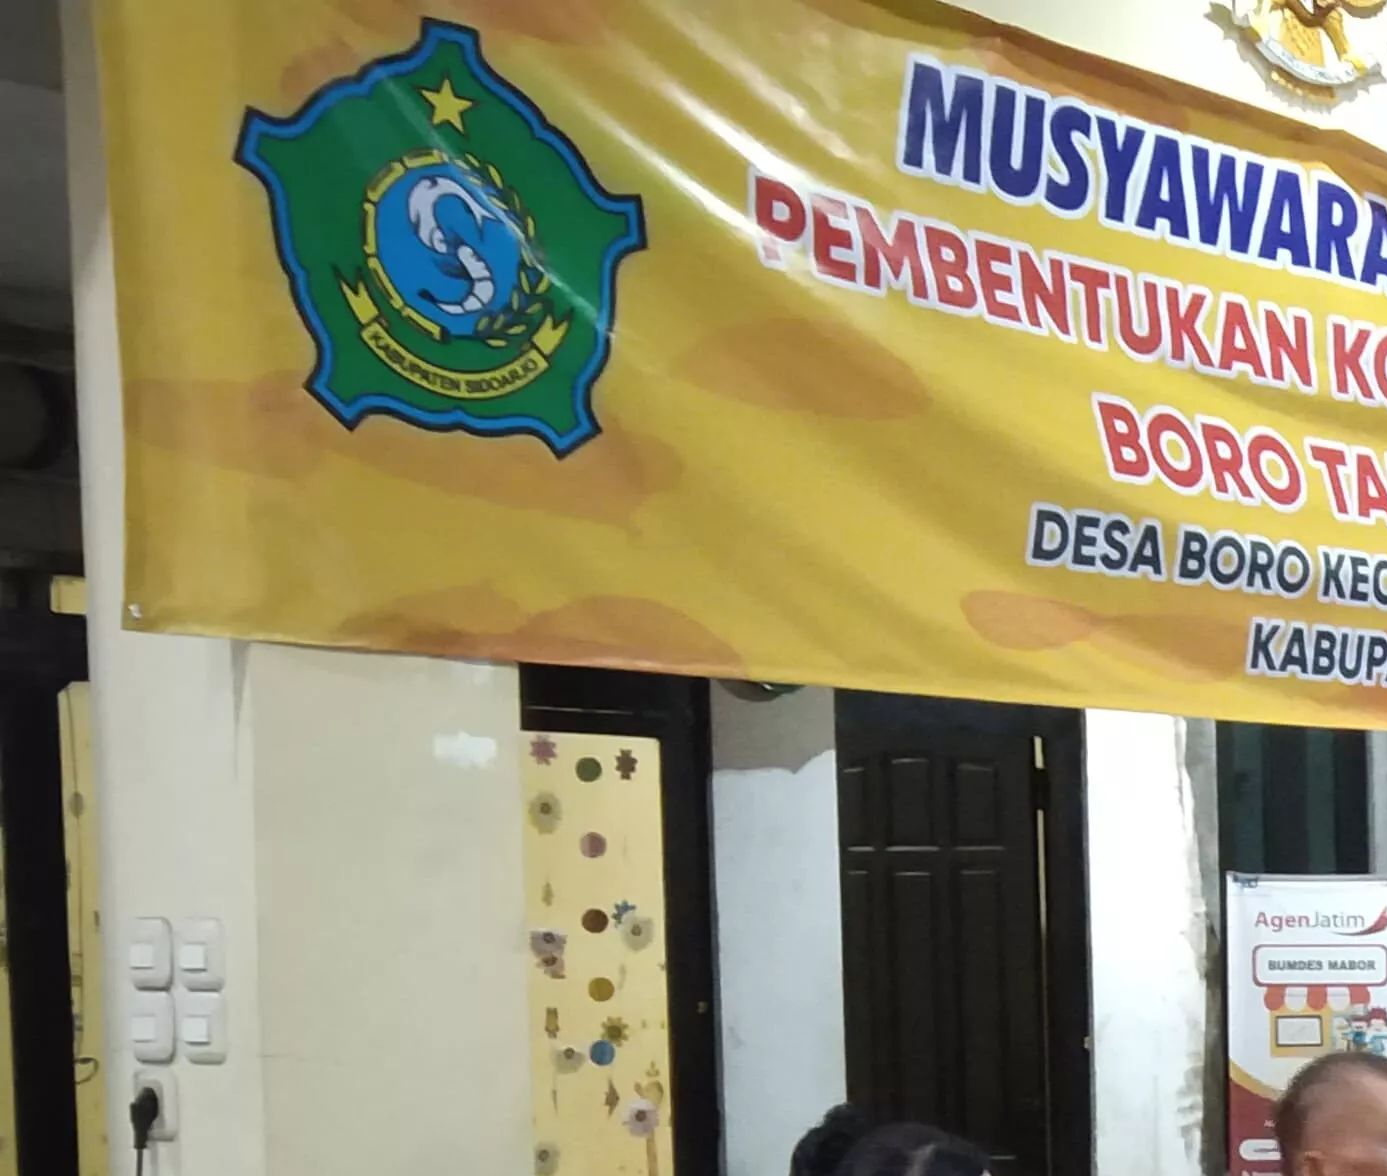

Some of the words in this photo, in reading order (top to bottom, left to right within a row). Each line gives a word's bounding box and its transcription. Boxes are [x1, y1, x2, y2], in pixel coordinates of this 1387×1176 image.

[754, 176, 1311, 385] PEMBENTUKAN
[368, 330, 461, 393] KABUPATEN
[466, 358, 539, 393] SIDOARJO
[1098, 402, 1300, 505] BORO
[1030, 509, 1162, 576] DESA
[1179, 531, 1310, 594] BORO
[1268, 959, 1323, 971] BUMDES
[1328, 959, 1376, 971] MABOR
